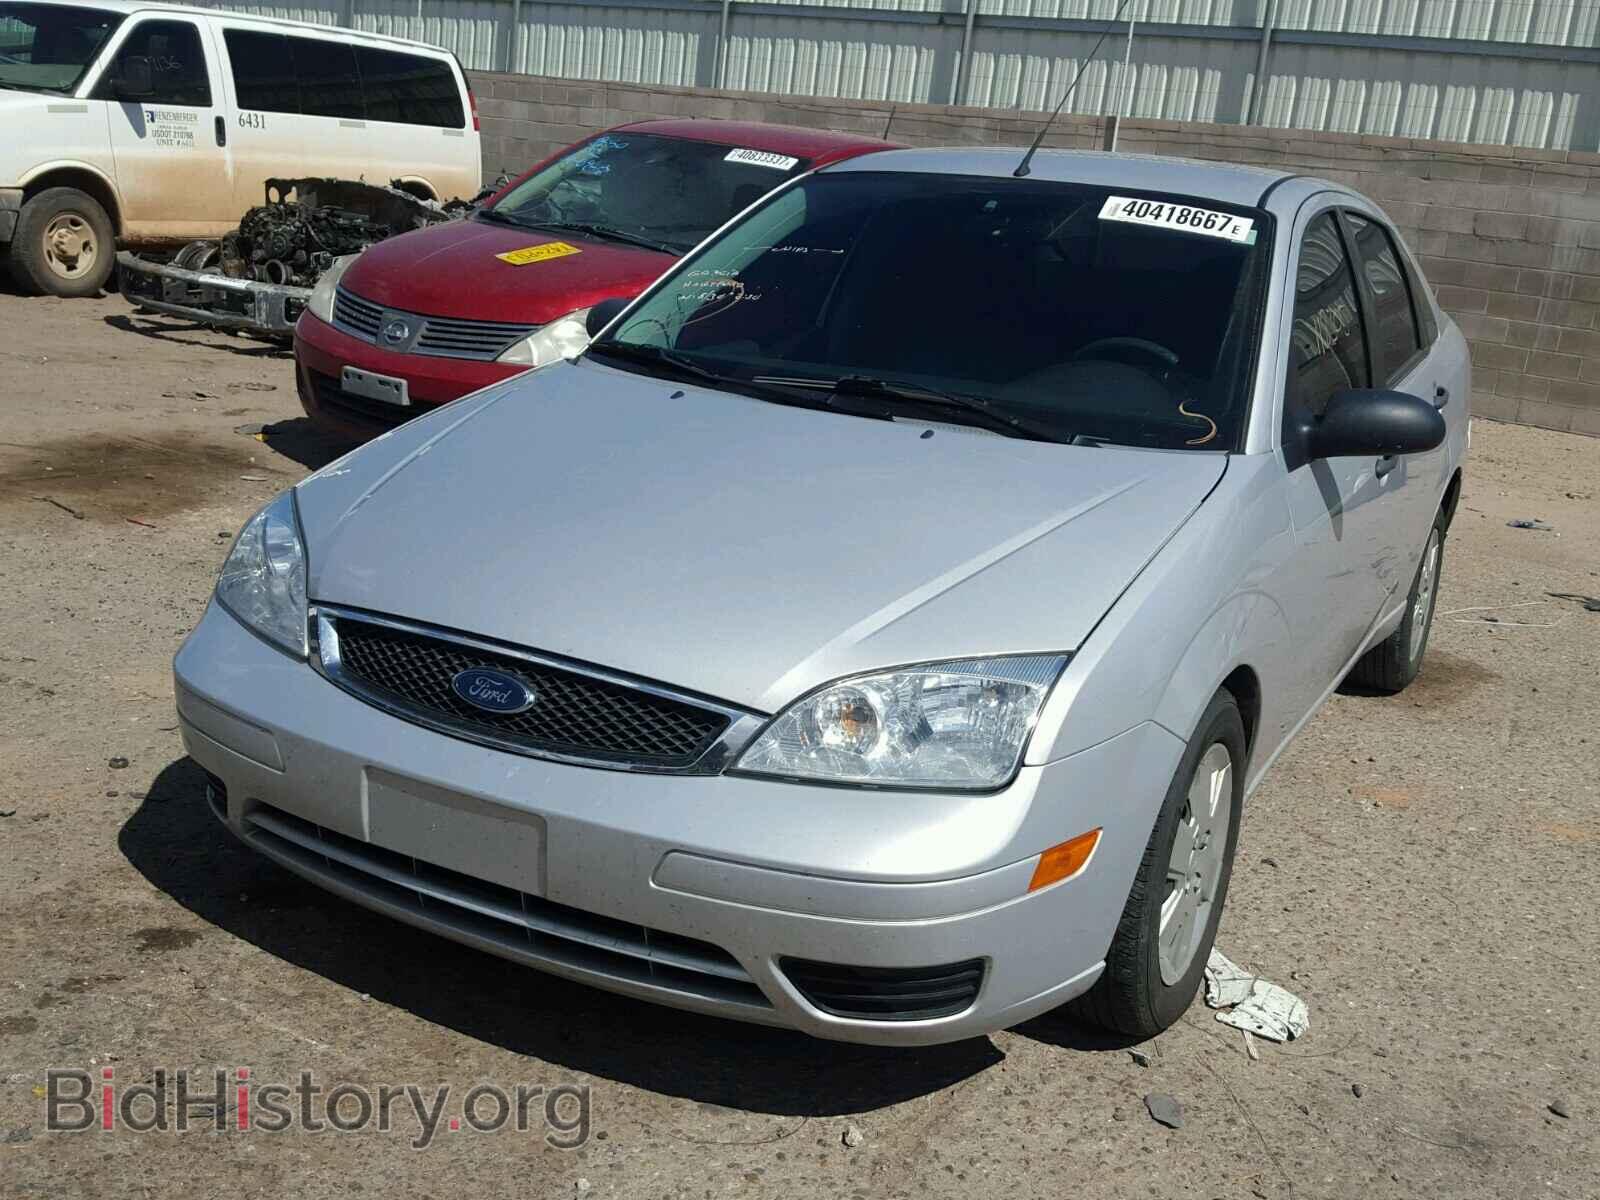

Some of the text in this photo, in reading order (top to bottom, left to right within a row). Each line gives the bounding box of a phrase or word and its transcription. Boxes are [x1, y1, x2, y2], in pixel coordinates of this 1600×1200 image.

[239, 112, 266, 129] 6431
[152, 129, 172, 138] USDOT
[1122, 200, 1233, 232] 40418667
[469, 676, 512, 704] Ford
